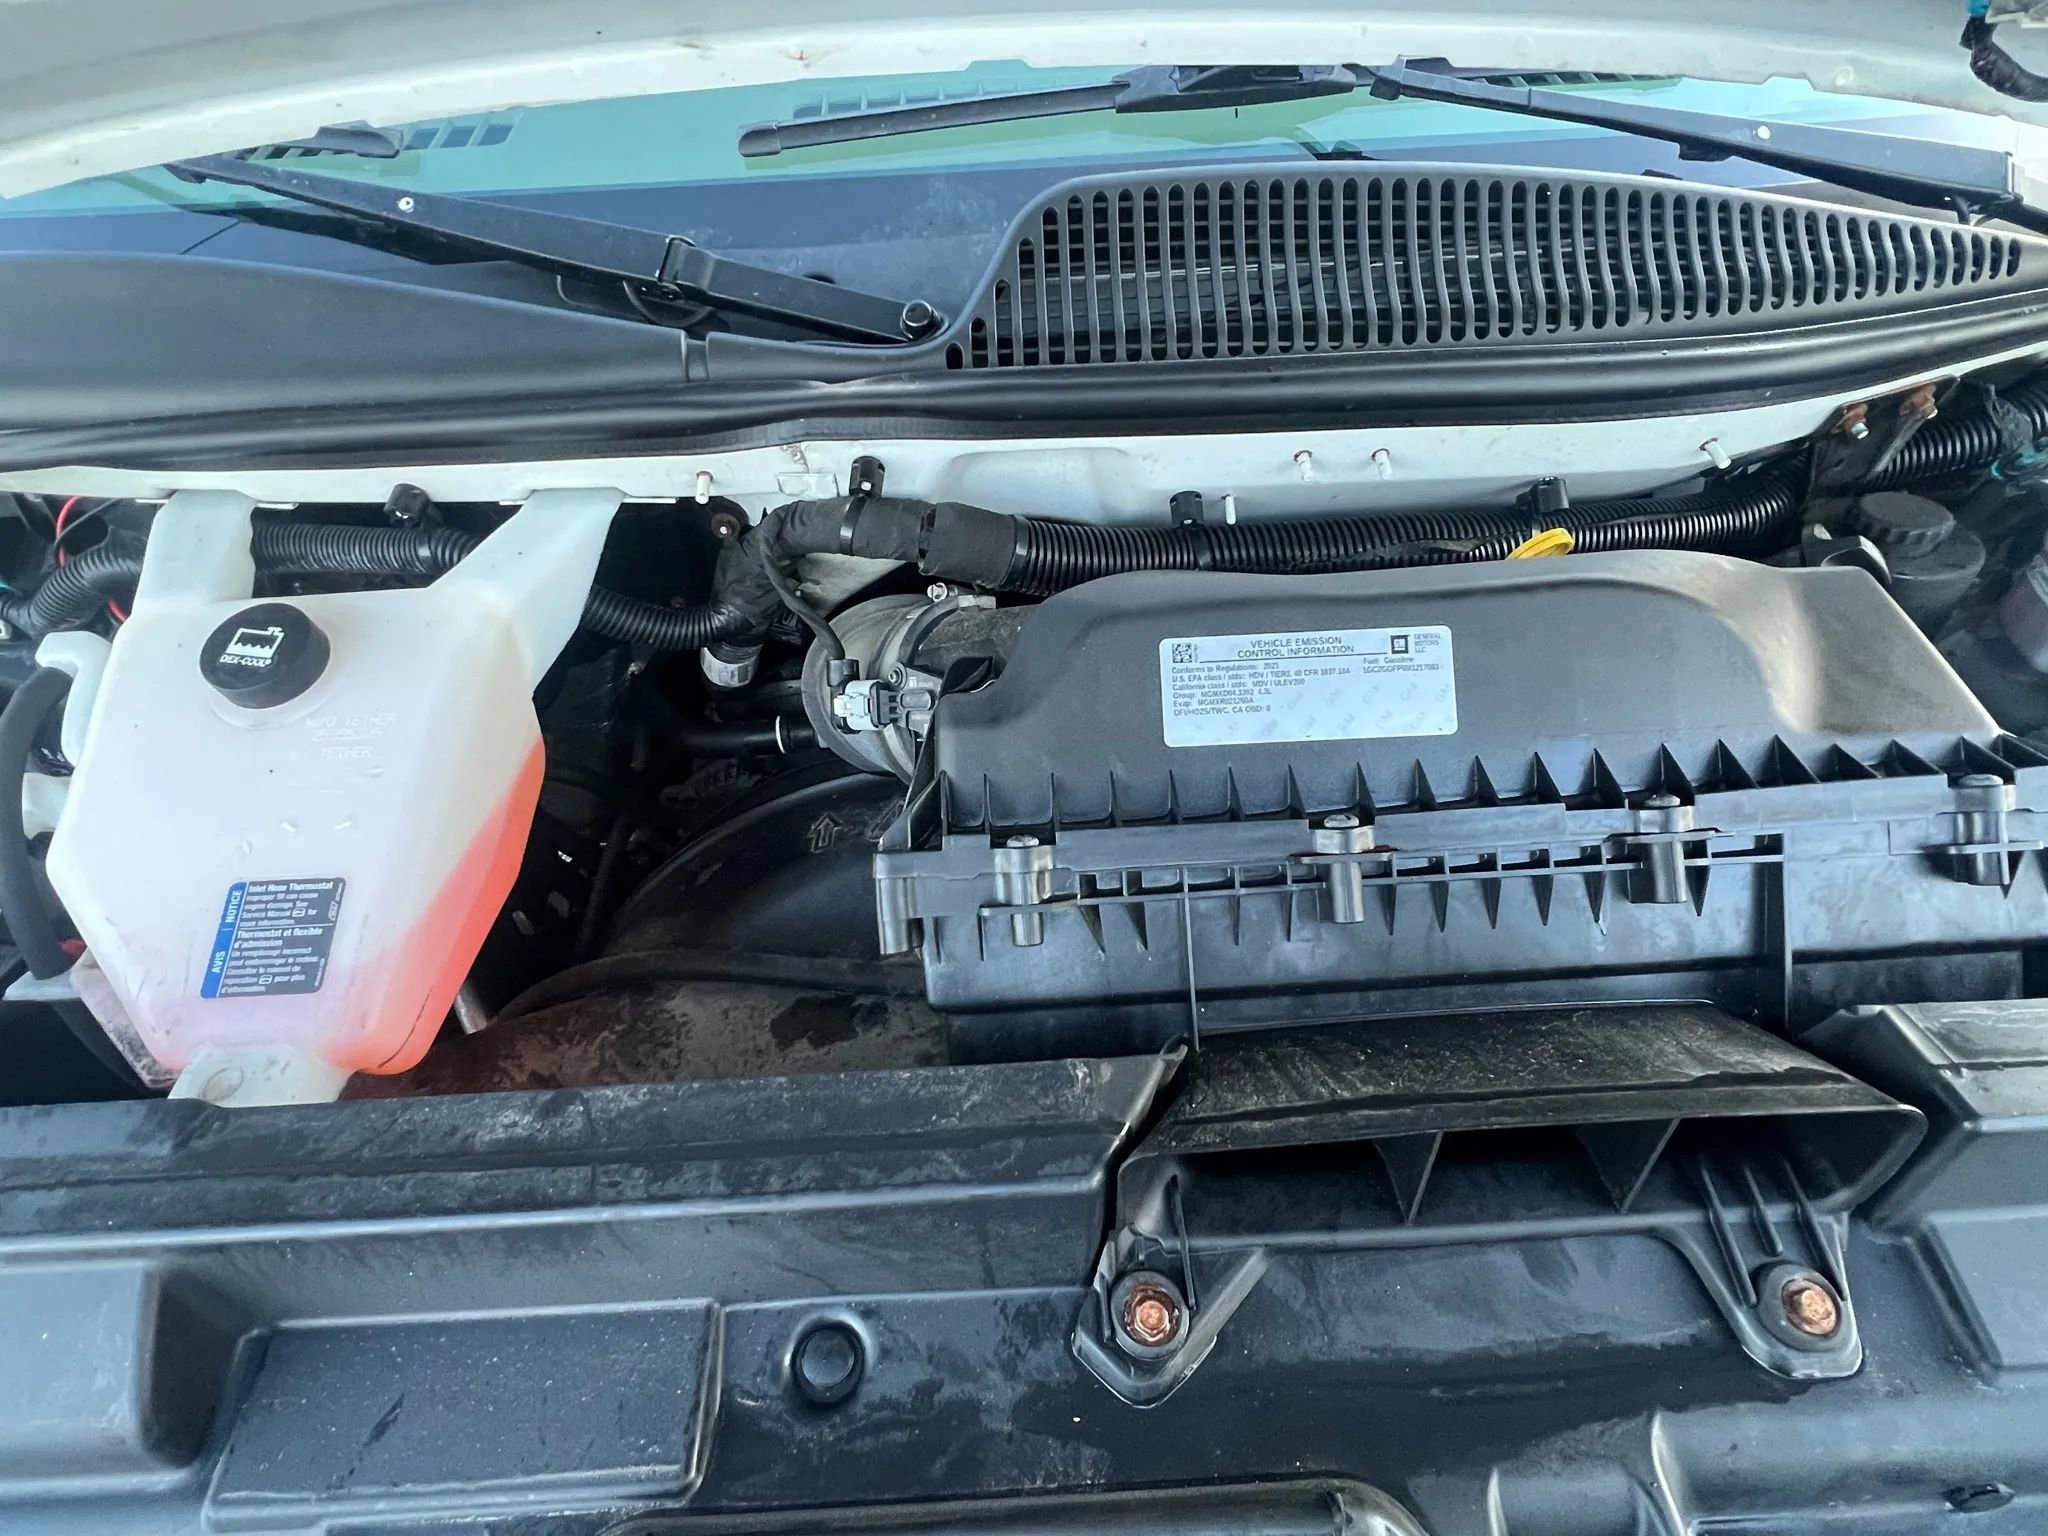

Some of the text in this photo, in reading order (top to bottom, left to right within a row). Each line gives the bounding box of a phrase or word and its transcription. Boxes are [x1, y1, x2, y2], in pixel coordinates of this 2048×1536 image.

[1250, 636, 1342, 648] VEHICLE EMISSION
[1237, 645, 1354, 658] CONTROL INFORMATION
[1383, 656, 1414, 665] Gasoline
[1172, 666, 1205, 674] Conforms
[1216, 663, 1258, 673] Regulations:
[1204, 673, 1222, 681] class
[1248, 671, 1265, 679] HDV
[1303, 668, 1319, 676] CFR
[1172, 683, 1206, 692] California
[1207, 682, 1225, 690] class
[1252, 680, 1269, 688] MDV
[1173, 692, 1197, 701] Group:
[1173, 701, 1194, 709] Evap:
[1232, 705, 1243, 713] CA
[289, 881, 333, 890] Thermostat
[225, 889, 243, 923] NOTICE
[237, 929, 282, 938] Thermostat
[283, 928, 292, 936] et
[211, 950, 226, 973] AVIS
